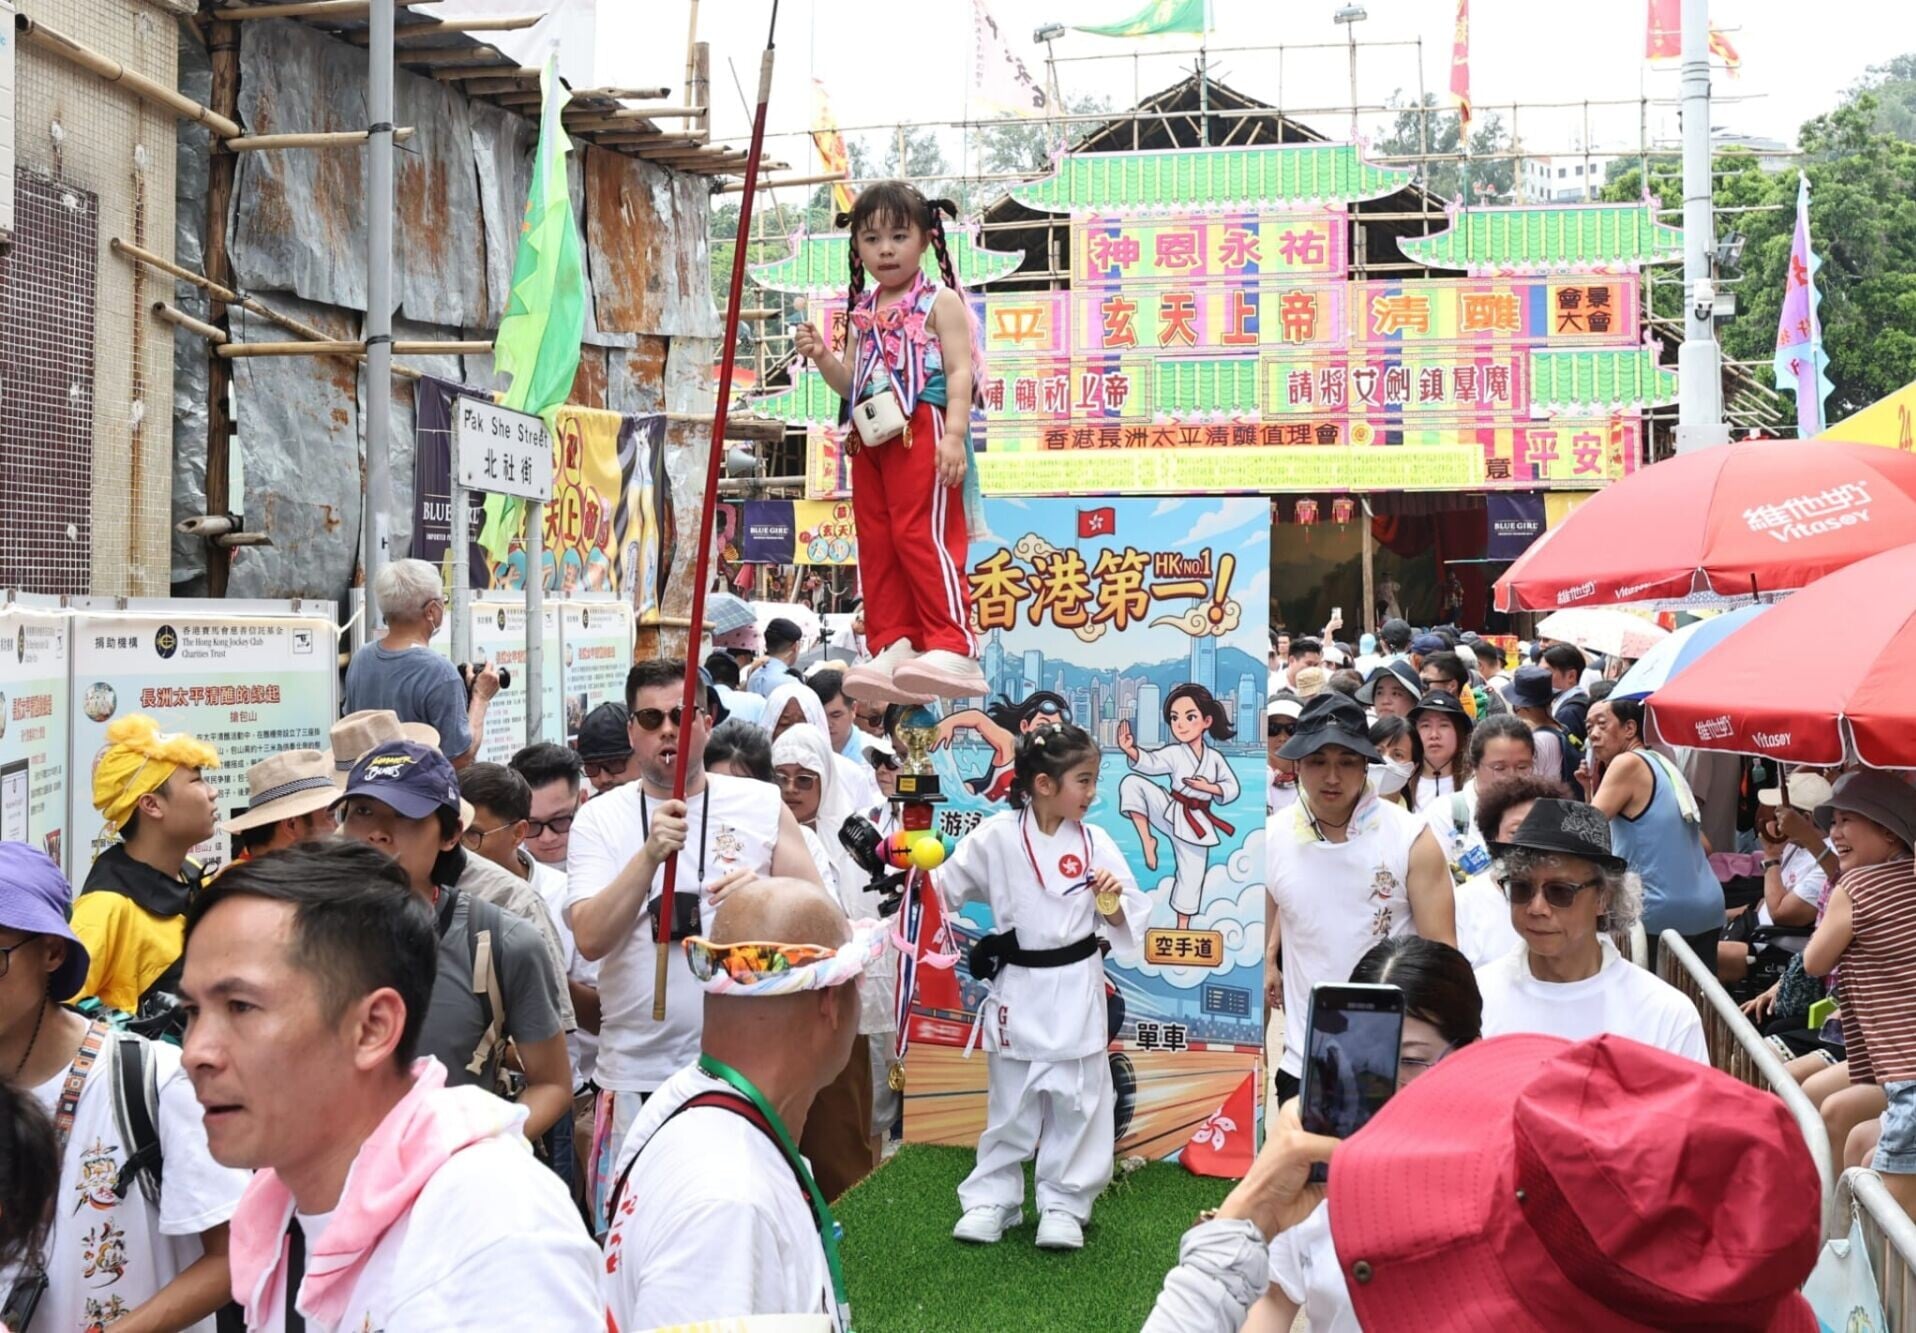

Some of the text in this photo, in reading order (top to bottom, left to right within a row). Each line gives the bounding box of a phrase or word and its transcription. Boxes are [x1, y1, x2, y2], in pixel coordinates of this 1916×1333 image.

[1092, 230, 1327, 270] 神恩永祐
[992, 308, 1046, 343] 平
[1101, 291, 1317, 348] 玄天上帝
[1372, 293, 1522, 335] 清醮
[464, 408, 549, 449] Pak She Street
[1044, 423, 1340, 450] 香港長洲太平清醮值理會
[1528, 430, 1604, 477] 平安
[484, 448, 533, 486] 北社街
[1485, 458, 1512, 480] 意
[423, 501, 451, 521] BLUE
[1742, 483, 1873, 532] 維他奶
[1494, 522, 1538, 530] BLUE GIRL
[1154, 552, 1182, 577] HK
[95, 636, 138, 649] 捐助機構
[182, 637, 263, 648] The Hong Kong Jockey Club
[182, 649, 226, 659] Charities Trust
[140, 685, 281, 709] 長洲太平清醮的緣起
[230, 710, 257, 723] 搶包山
[1155, 935, 1214, 959] 空手道
[1136, 1023, 1187, 1052] 單車
